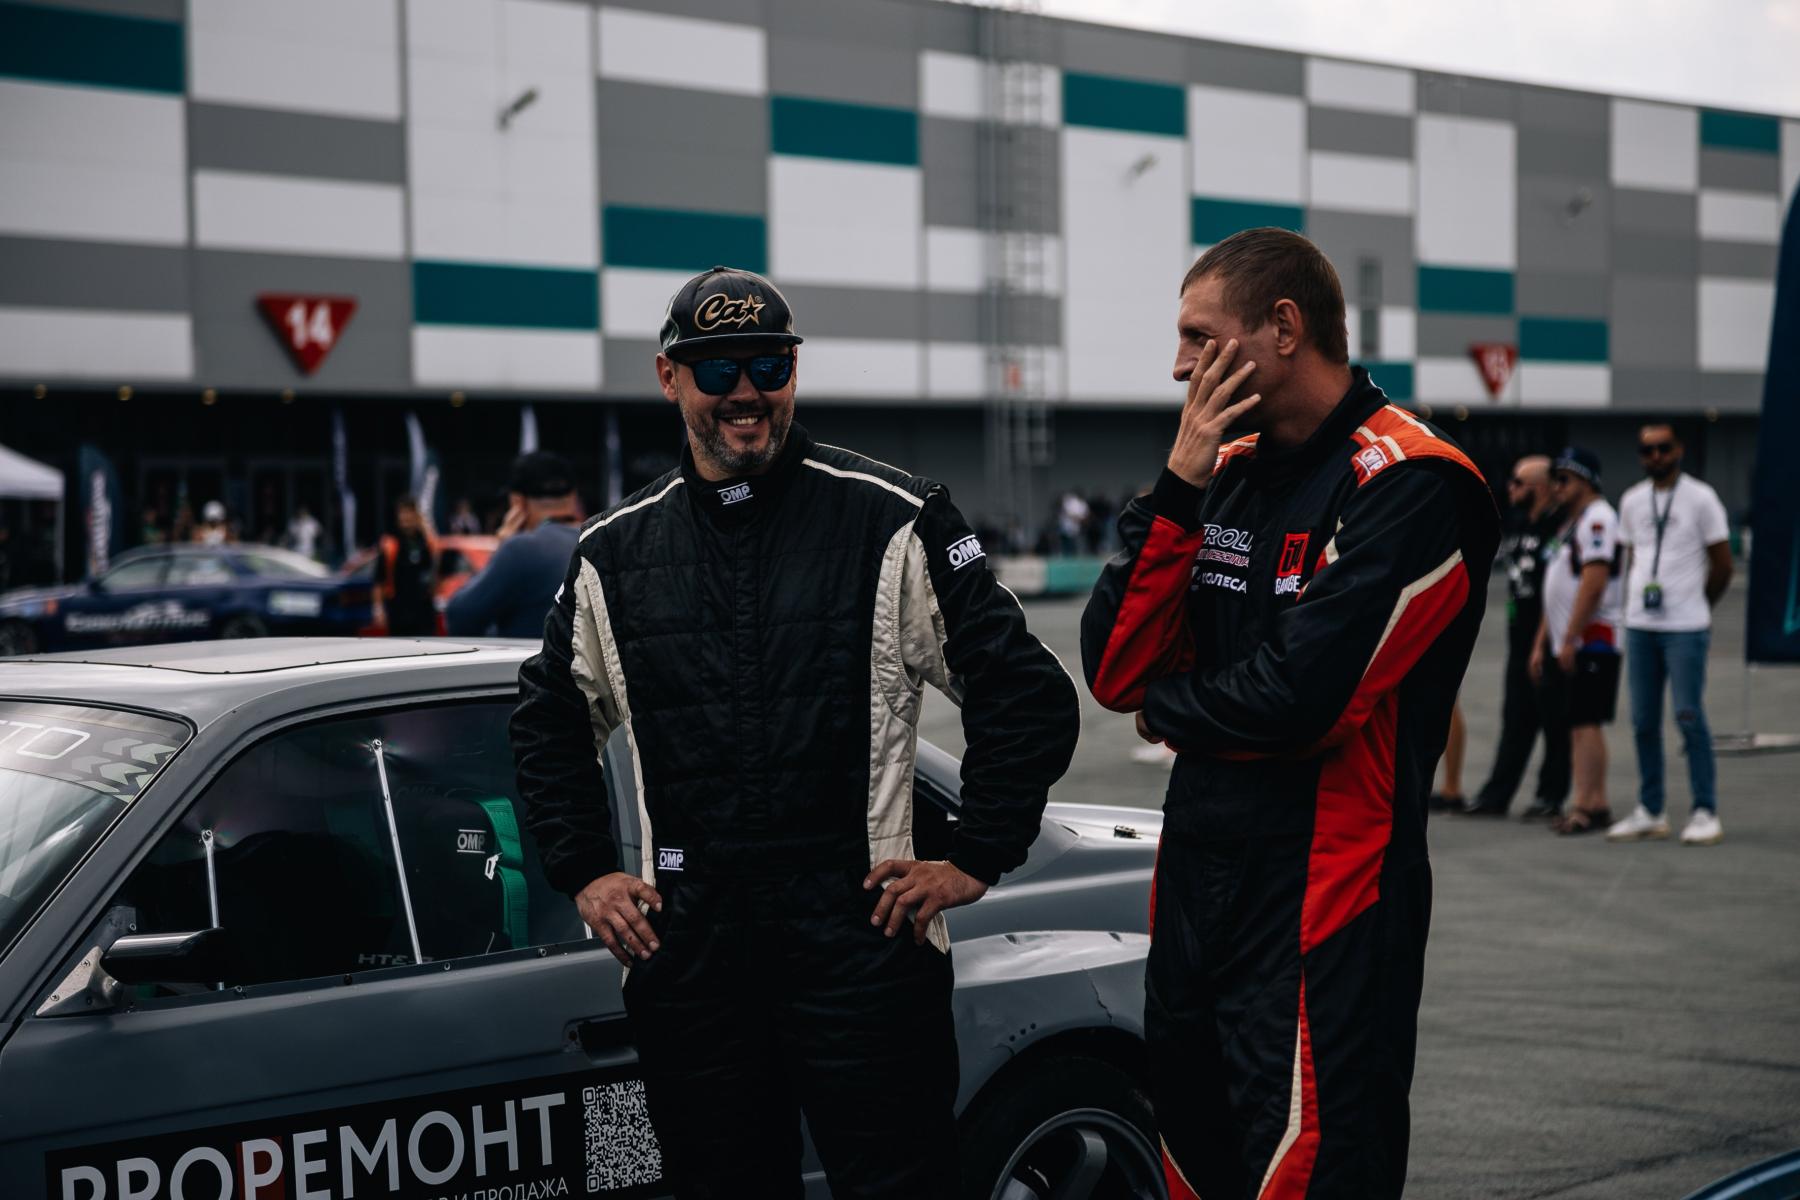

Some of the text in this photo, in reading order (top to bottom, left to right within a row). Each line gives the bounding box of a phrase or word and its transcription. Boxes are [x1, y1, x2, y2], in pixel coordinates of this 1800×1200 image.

[285, 300, 335, 350] 14
[719, 484, 751, 503] OMP
[948, 537, 983, 568] OMP
[0, 720, 91, 759] TO
[457, 832, 486, 852] OMP
[659, 850, 684, 869] OMP
[474, 1177, 569, 1200] ПРОДАЖА
